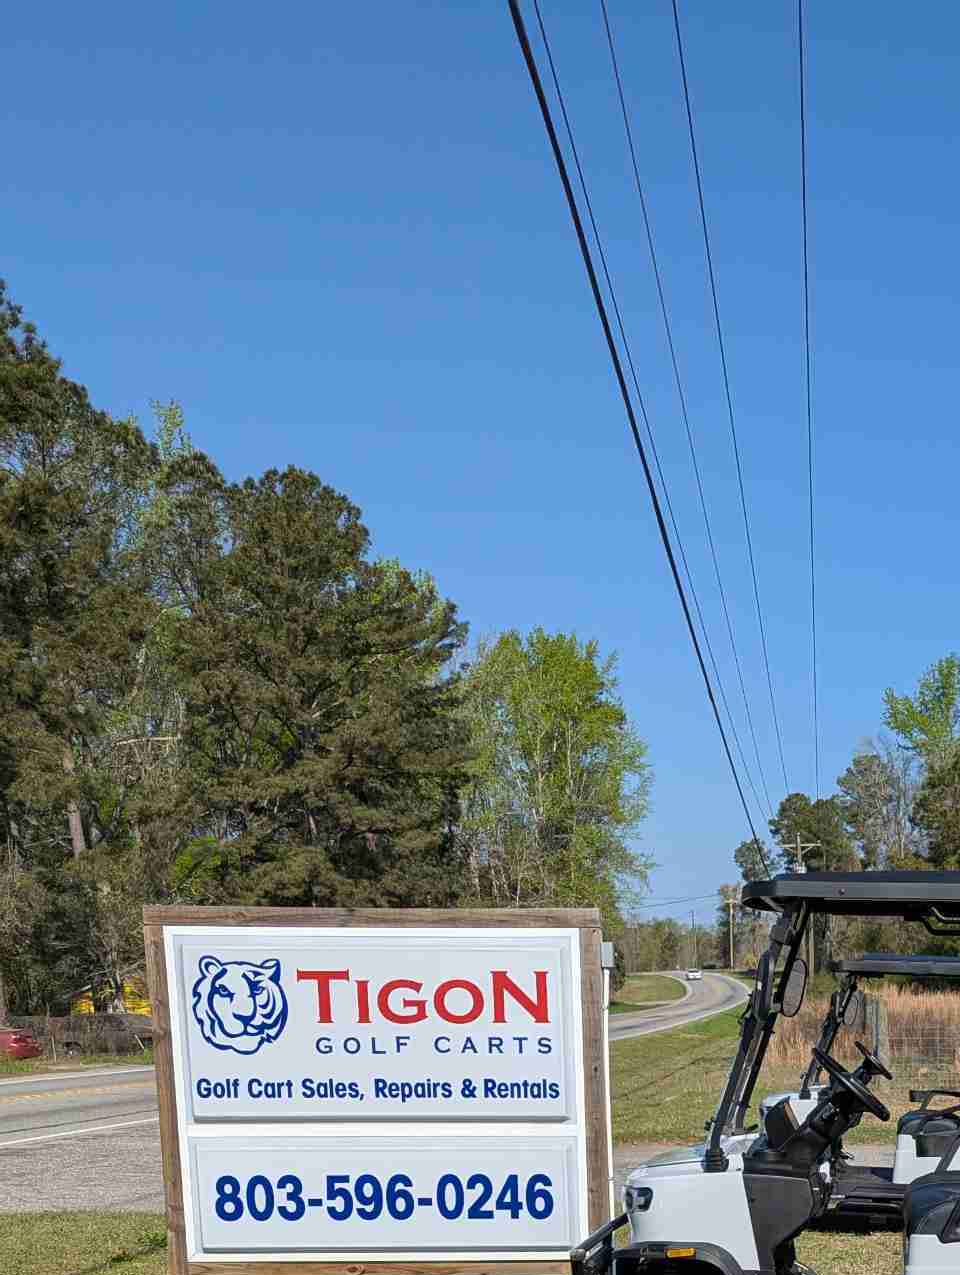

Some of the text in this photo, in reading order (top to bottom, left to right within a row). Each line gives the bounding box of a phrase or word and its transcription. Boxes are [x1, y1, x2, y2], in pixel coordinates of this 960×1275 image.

[297, 969, 549, 1024] TIGON
[316, 1036, 552, 1054] GOLF CARTS
[197, 1079, 559, 1103] Golf Cart Sales, Repairs & Rentals
[215, 1174, 553, 1221] 803-596-0246
